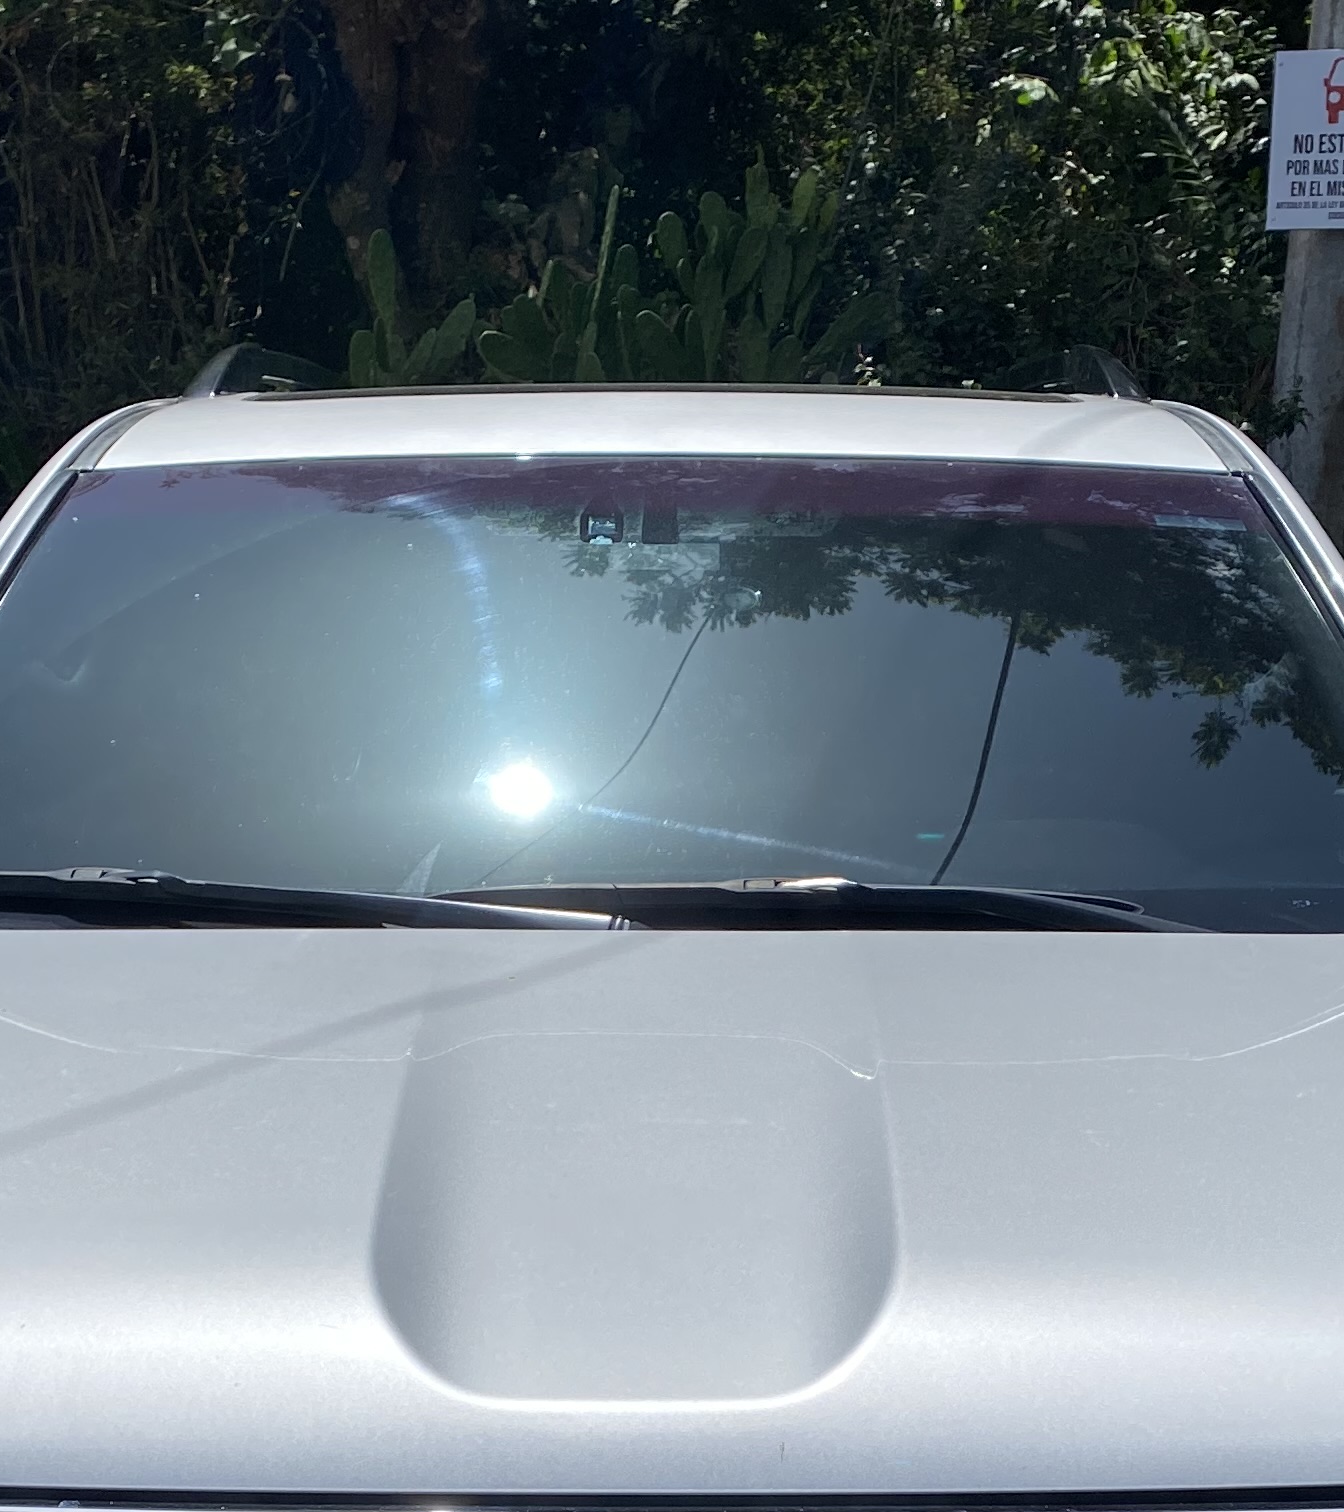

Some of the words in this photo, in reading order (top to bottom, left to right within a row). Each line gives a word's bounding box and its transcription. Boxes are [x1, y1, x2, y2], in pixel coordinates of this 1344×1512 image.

[1293, 133, 1314, 154] NO
[1286, 160, 1310, 176] POR
[1313, 159, 1339, 175] MAS
[1290, 181, 1306, 197] EN
[1309, 180, 1323, 197] EL
